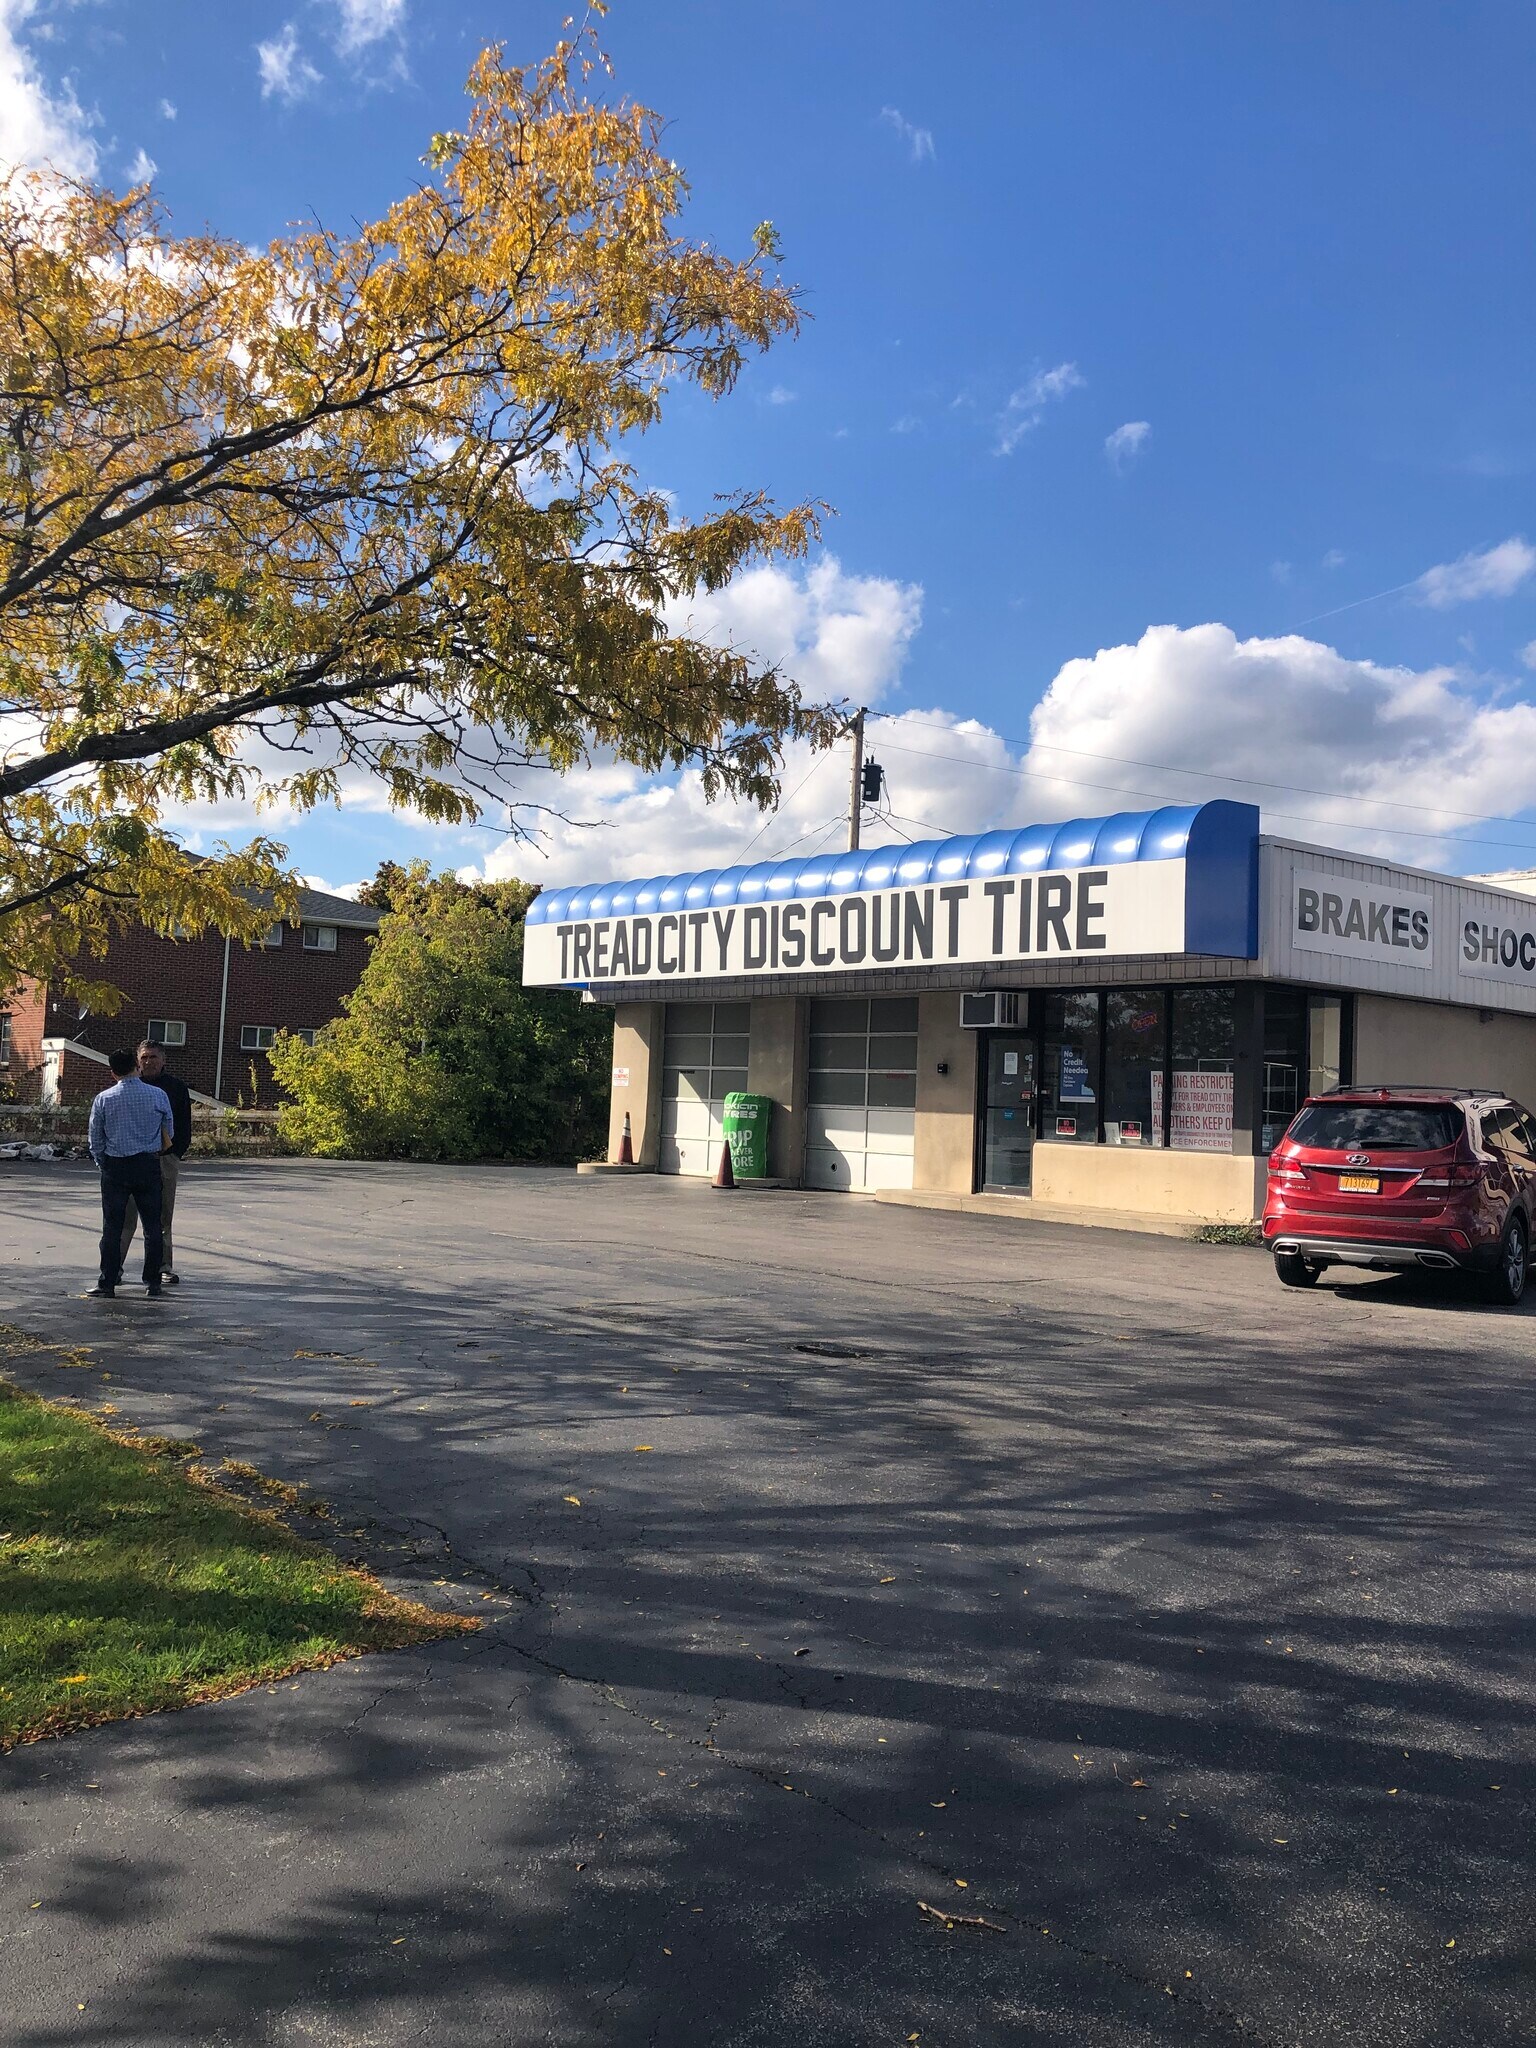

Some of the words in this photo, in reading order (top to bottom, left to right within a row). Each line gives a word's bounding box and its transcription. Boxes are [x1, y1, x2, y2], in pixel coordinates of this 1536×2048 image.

[557, 917, 652, 979] TREAD
[657, 909, 736, 974] CITY
[744, 885, 969, 970] DISCOUNT
[984, 871, 1108, 955] TIRE
[1298, 888, 1429, 951] BRAKES
[1063, 1050, 1073, 1058] No
[1179, 1092, 1189, 1101] FOR
[1190, 1092, 1208, 1102] TREAD
[1209, 1093, 1222, 1102] CITY
[1187, 1103, 1191, 1111] &
[1192, 1103, 1225, 1113] EMPLOYEES
[1203, 1117, 1223, 1130] KEEP
